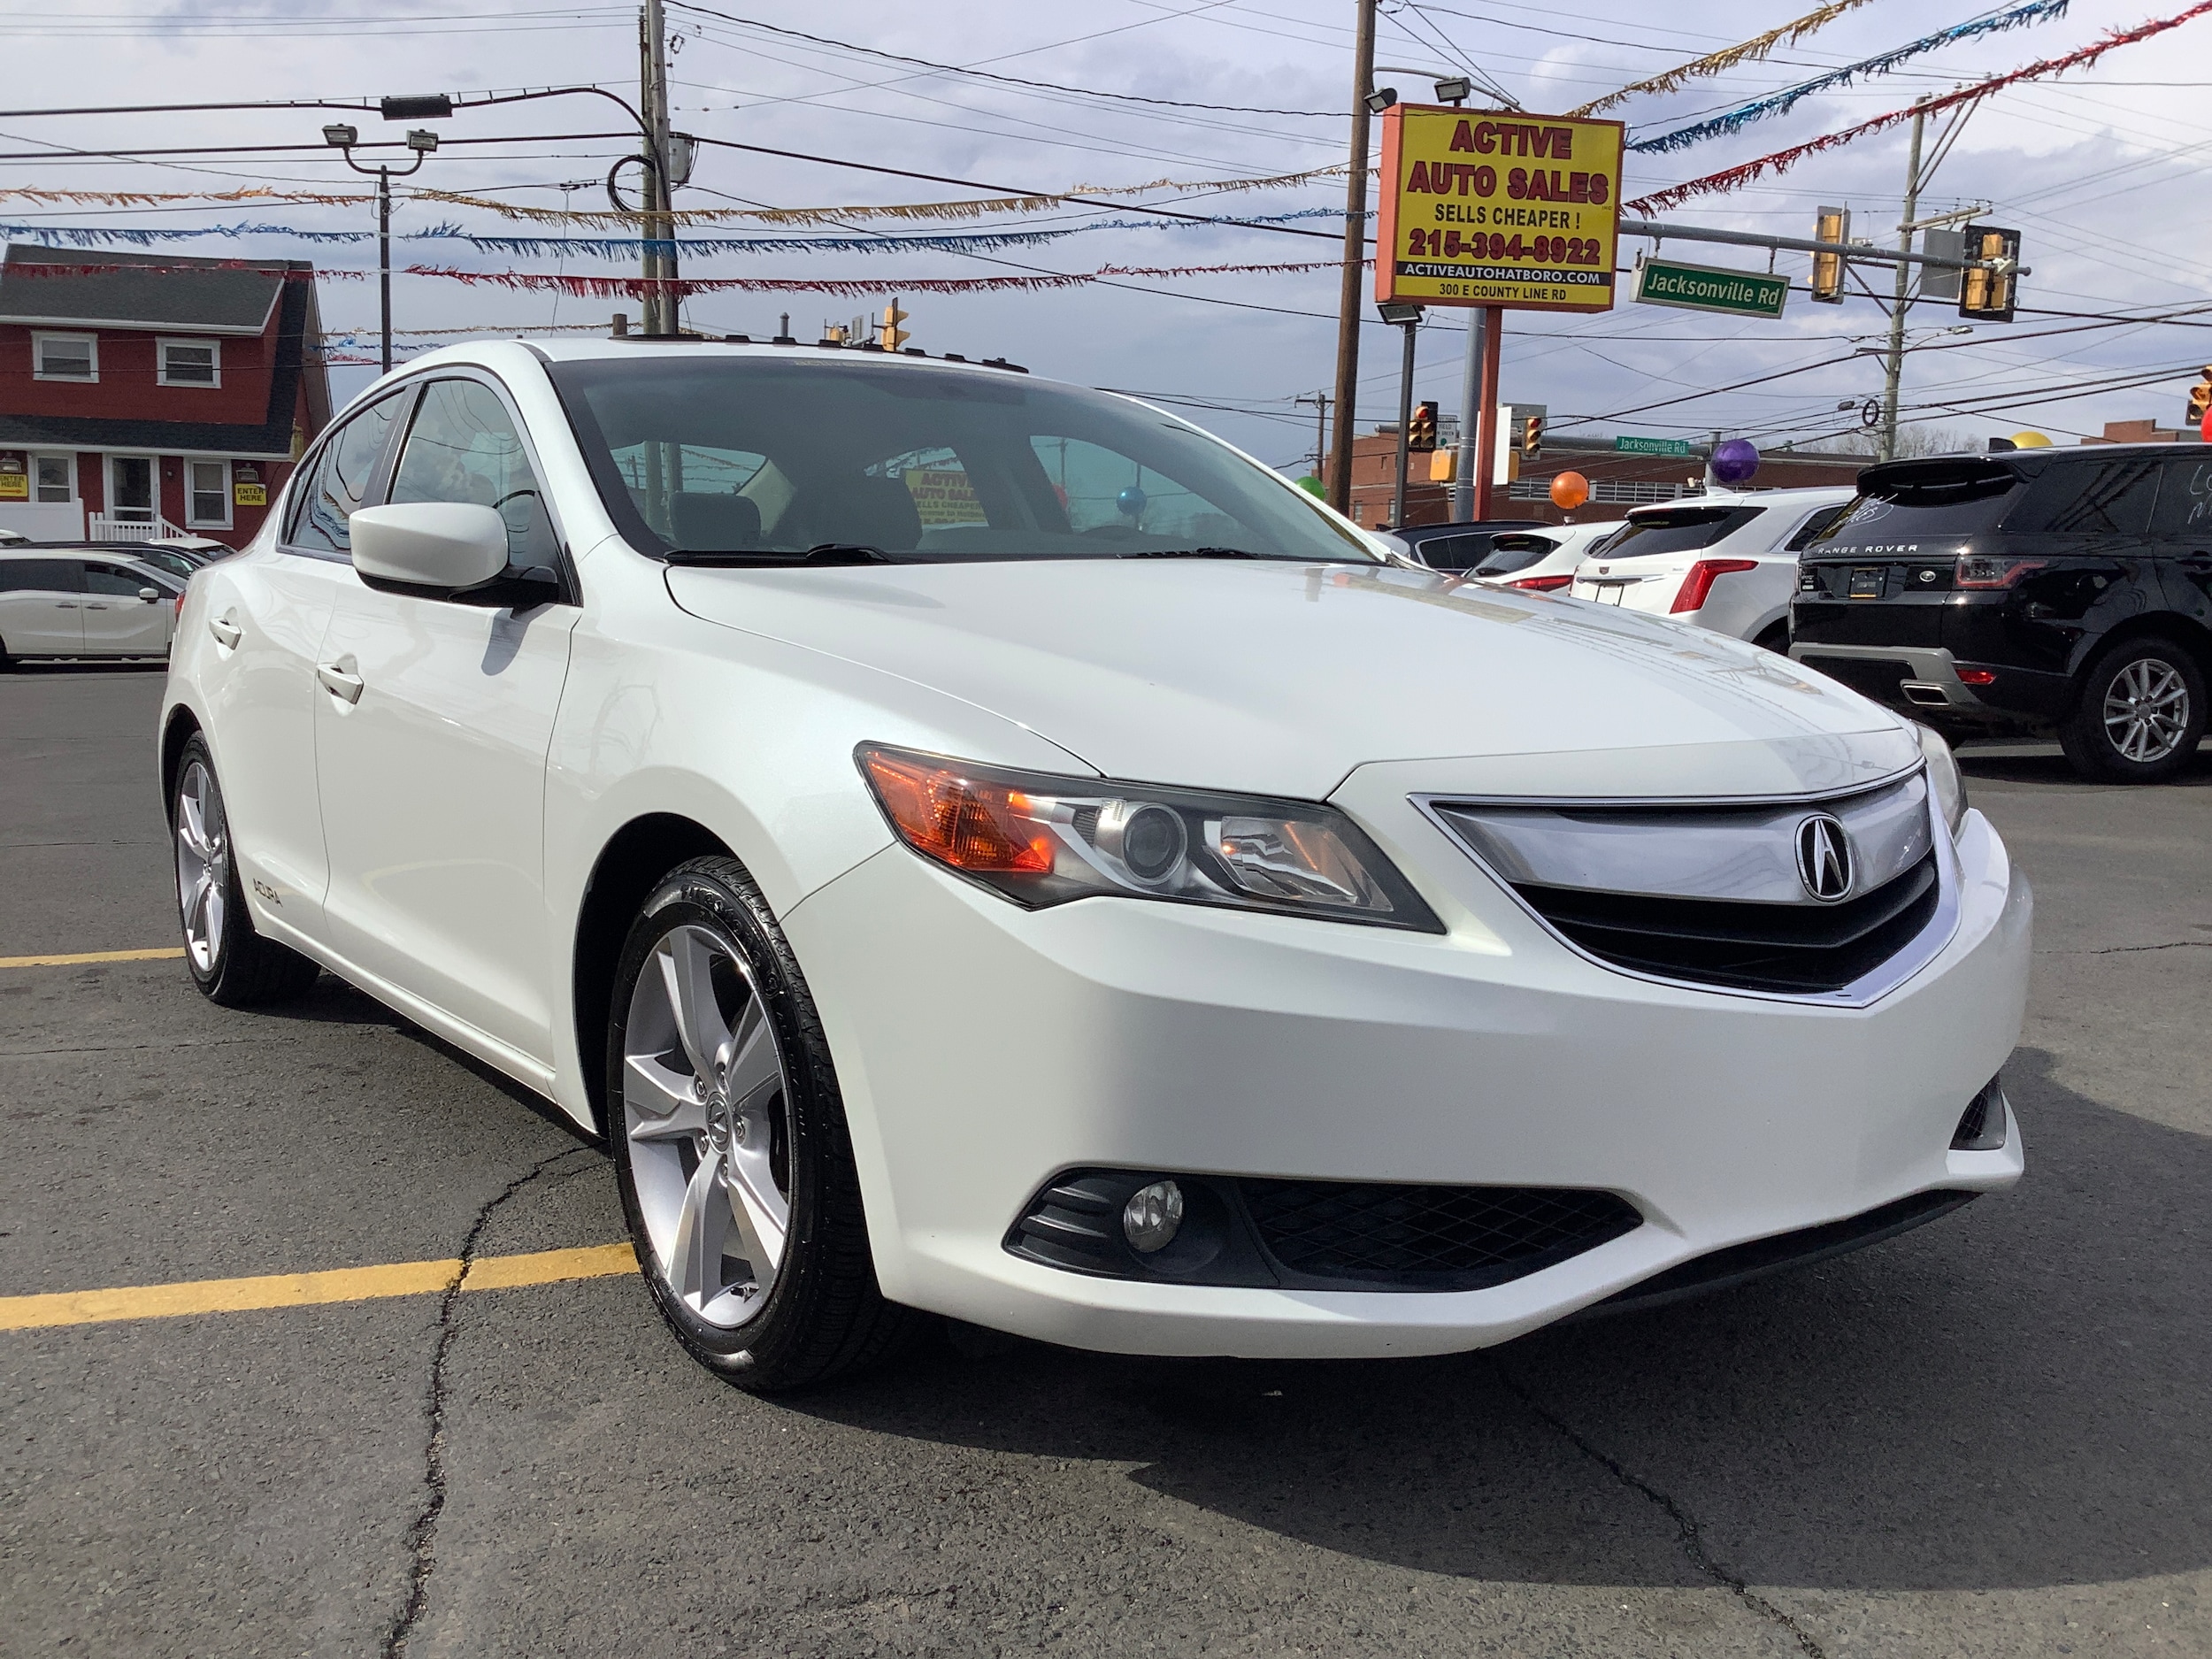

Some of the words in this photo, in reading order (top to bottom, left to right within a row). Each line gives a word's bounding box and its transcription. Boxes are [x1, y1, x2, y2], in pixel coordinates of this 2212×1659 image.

[1449, 119, 1573, 160] ACTIVE
[1407, 160, 1497, 197] AUTO
[1507, 167, 1609, 204] SALES
[1434, 204, 1486, 225] SELLS
[1492, 207, 1571, 229] CHEAPER
[1408, 227, 1601, 265] 215-394-8922
[1404, 264, 1601, 285] ACTIVEAUTOHATBORO.COM
[1439, 283, 1459, 296] 300
[1463, 284, 1470, 296] E
[1472, 285, 1520, 299] COUNTY
[1522, 288, 1548, 300] LINE
[1551, 288, 1566, 301] RD
[1647, 273, 1754, 303] Jacksonville
[1757, 287, 1780, 306] Rd
[1619, 438, 1672, 453] Jacksonville
[1674, 442, 1686, 454] Rd
[921, 472, 969, 487] ACTIV
[1817, 546, 1858, 555] RANGE
[1864, 544, 1918, 553] ROVER
[252, 878, 283, 908] ACURA
